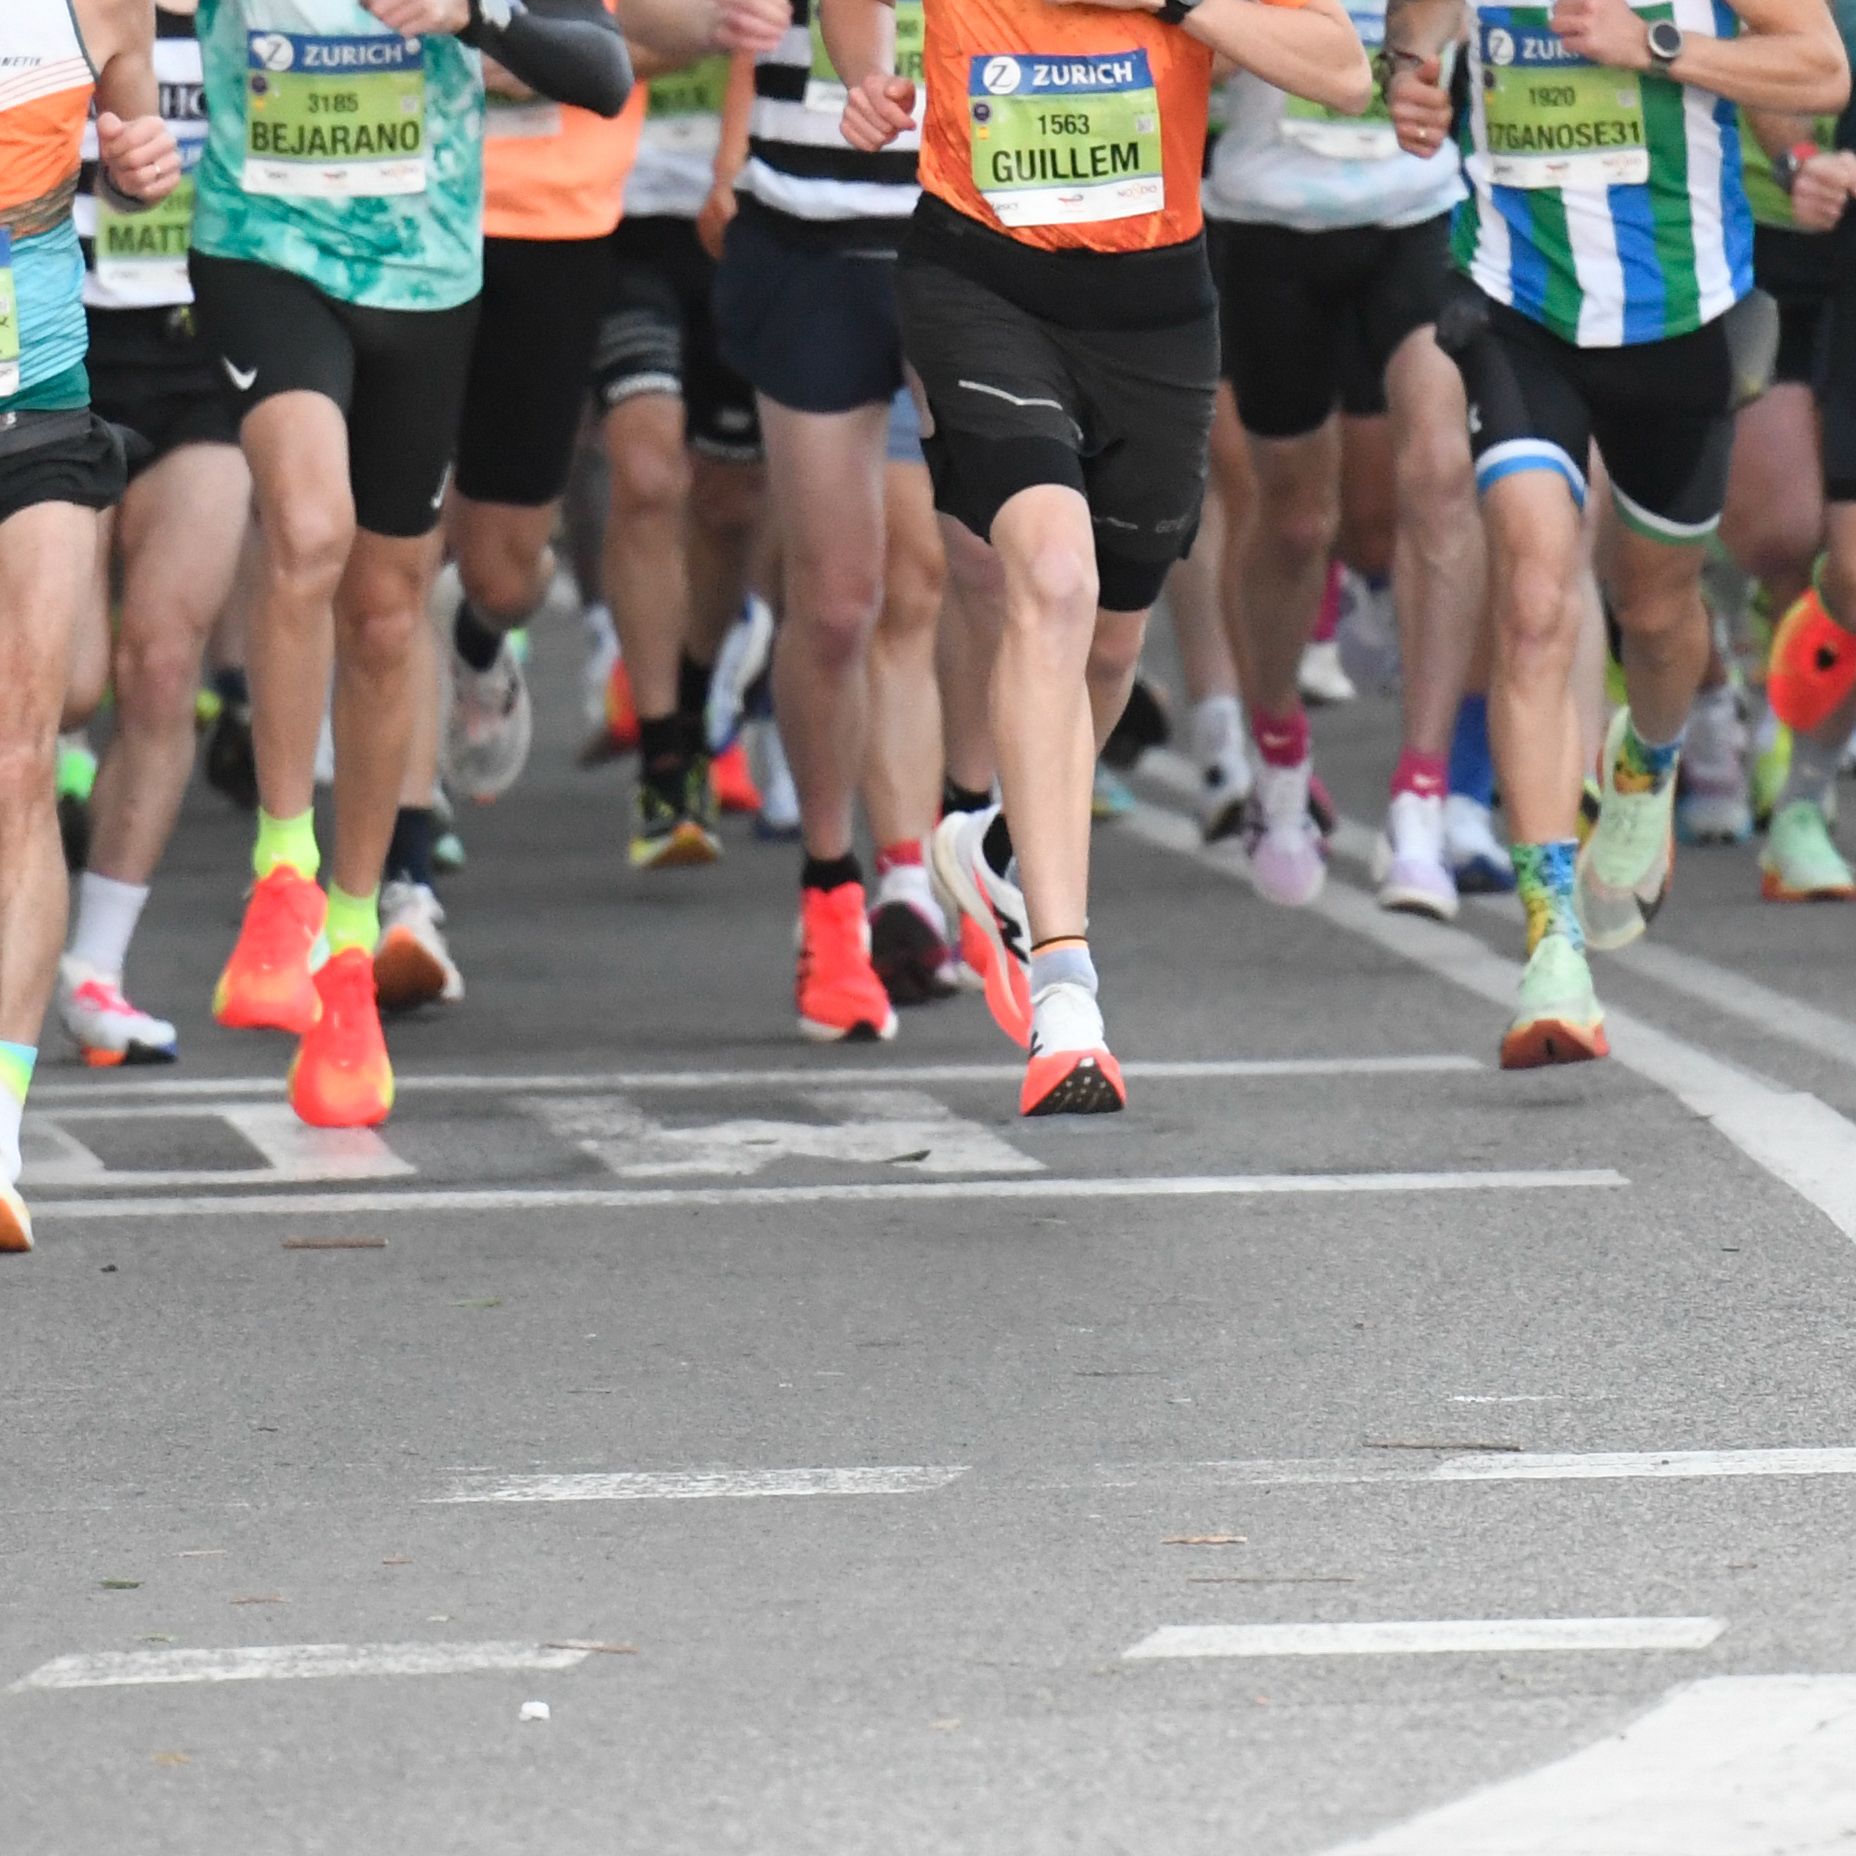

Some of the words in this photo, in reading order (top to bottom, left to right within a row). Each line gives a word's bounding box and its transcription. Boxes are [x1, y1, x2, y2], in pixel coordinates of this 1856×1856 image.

[301, 42, 404, 69] ZURICH
[1032, 60, 1133, 87] ZURICH
[307, 92, 359, 113] 3185
[1529, 86, 1576, 107] 1920
[251, 120, 421, 154] BEJARANO
[1038, 113, 1090, 135] 1563
[991, 142, 1139, 183] GUILLEM
